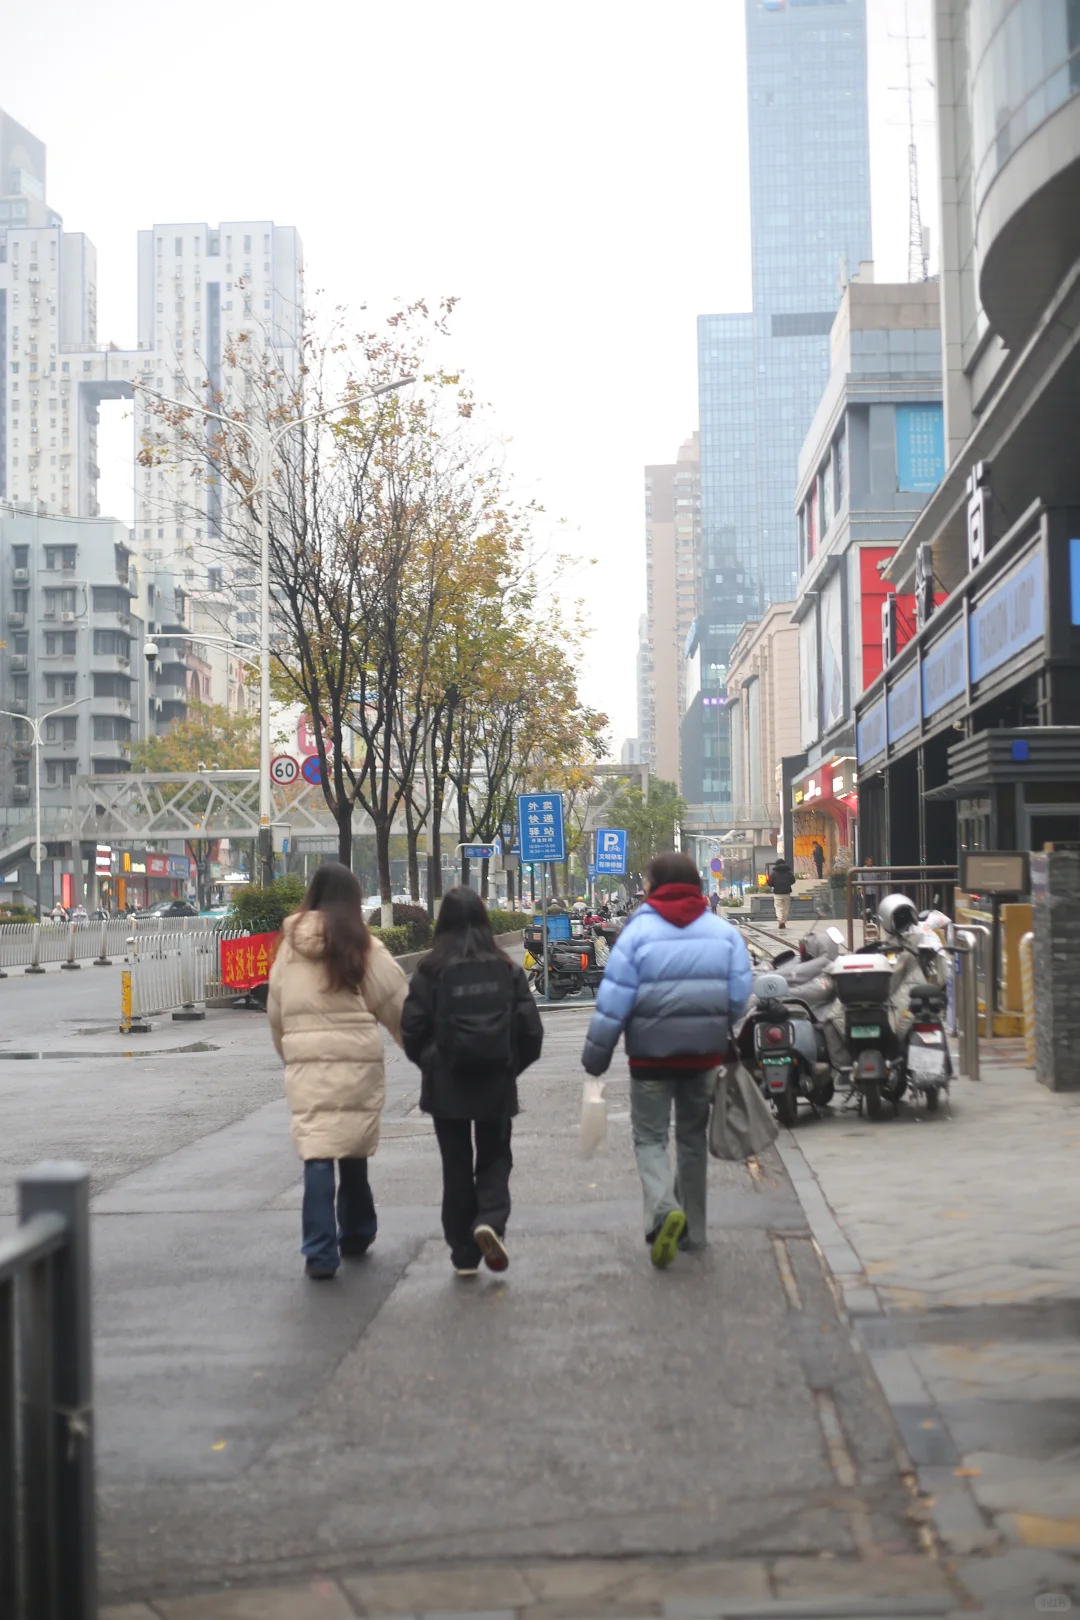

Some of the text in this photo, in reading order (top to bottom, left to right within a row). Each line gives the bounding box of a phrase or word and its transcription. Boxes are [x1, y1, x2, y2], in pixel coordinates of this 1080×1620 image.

[275, 763, 294, 778] 60
[528, 801, 553, 811] 外卖
[528, 814, 554, 824] 快递
[603, 833, 619, 851] P
